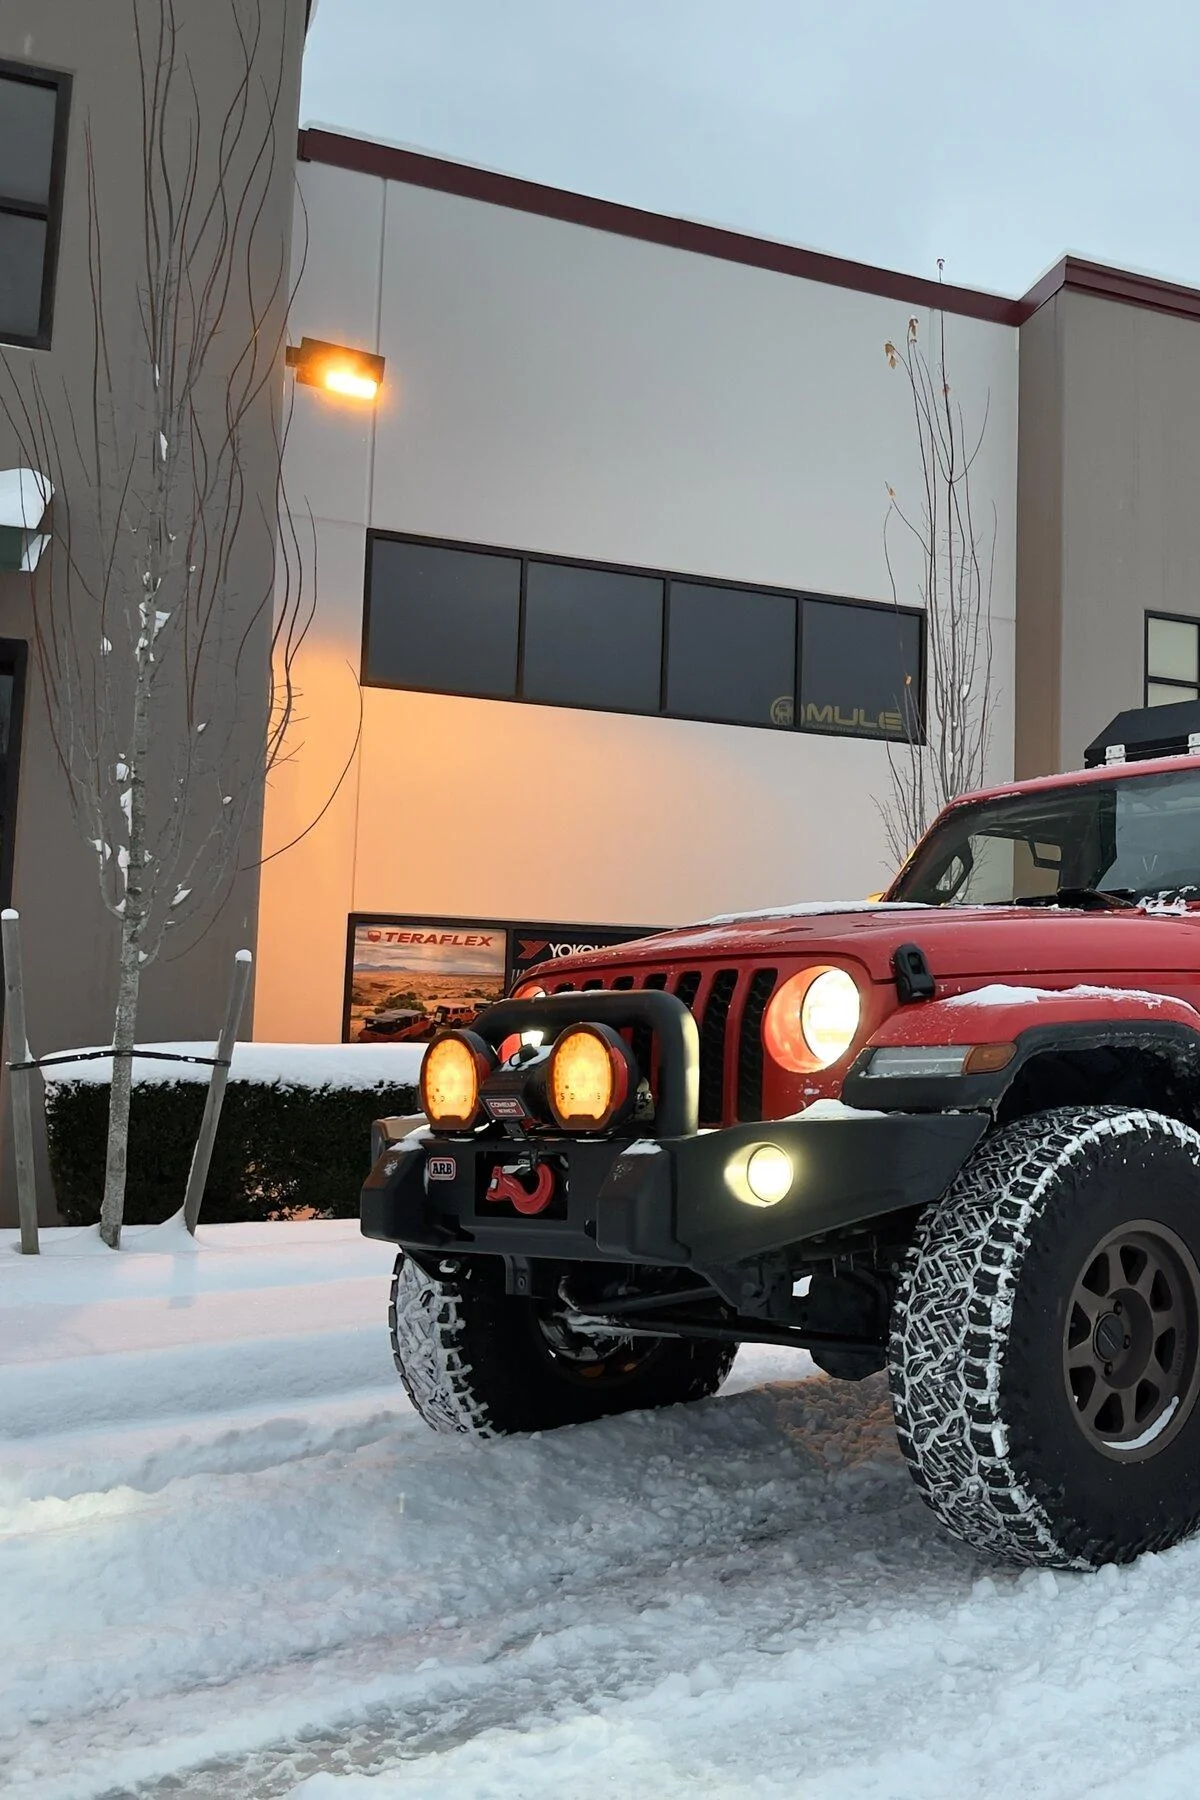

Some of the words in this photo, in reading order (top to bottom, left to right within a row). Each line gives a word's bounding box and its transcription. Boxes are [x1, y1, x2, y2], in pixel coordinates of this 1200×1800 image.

[806, 702, 903, 731] MULE
[385, 932, 493, 947] TERAFLEX
[432, 1163, 452, 1175] ARB
